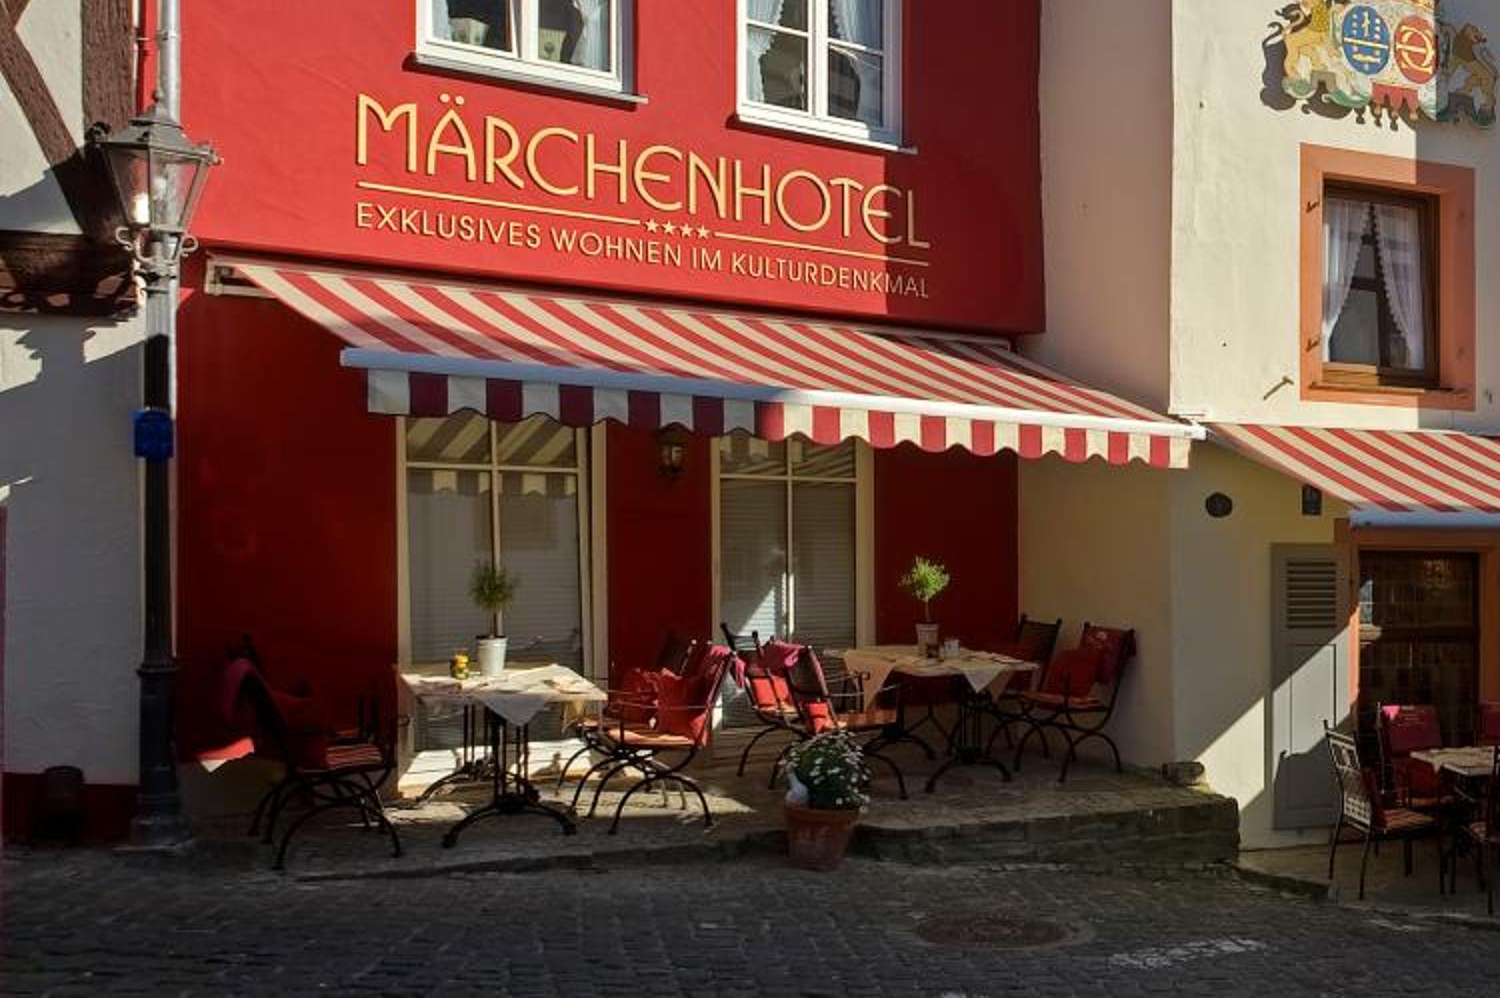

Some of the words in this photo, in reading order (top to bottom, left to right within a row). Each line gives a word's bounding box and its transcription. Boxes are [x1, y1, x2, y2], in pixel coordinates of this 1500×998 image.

[356, 93, 931, 250] MÄRCHENHOTEL
[356, 202, 542, 250] EXKLUSIVES
[551, 228, 682, 268] WOHNEN
[691, 246, 723, 271] IM
[731, 253, 930, 300] KULTURDENKMAL
